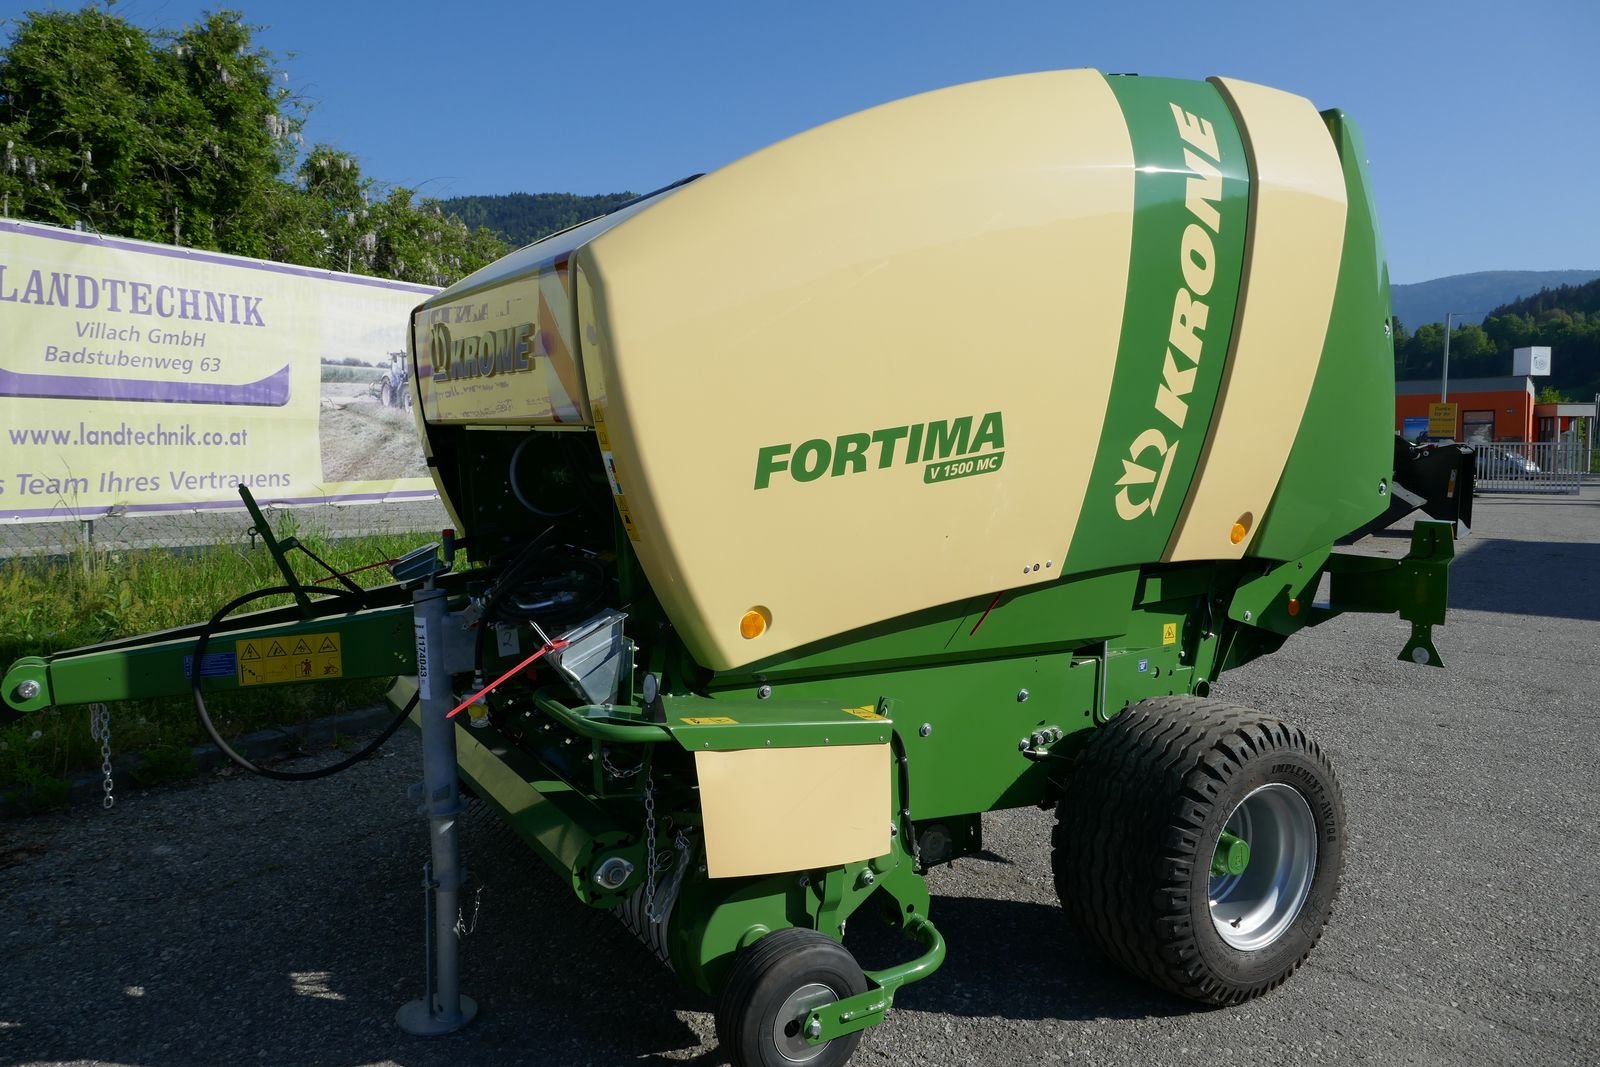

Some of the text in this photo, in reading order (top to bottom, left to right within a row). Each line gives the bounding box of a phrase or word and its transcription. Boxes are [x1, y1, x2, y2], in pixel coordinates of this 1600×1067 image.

[1154, 102, 1223, 429] KRONE
[0, 265, 265, 327] LANDTECHNIK
[75, 321, 206, 348] Villach GmbH
[450, 322, 536, 379] KRONE
[44, 346, 222, 375] Badstubenweg 63
[9, 421, 248, 447] www.landtechnik.co.at
[754, 411, 1005, 490] FORTIMA
[16, 473, 89, 496] Team
[99, 471, 160, 493] Ihres
[169, 471, 291, 491] Vertrauens
[931, 456, 998, 479] V 1500 MC
[418, 635, 428, 678] 1174043
